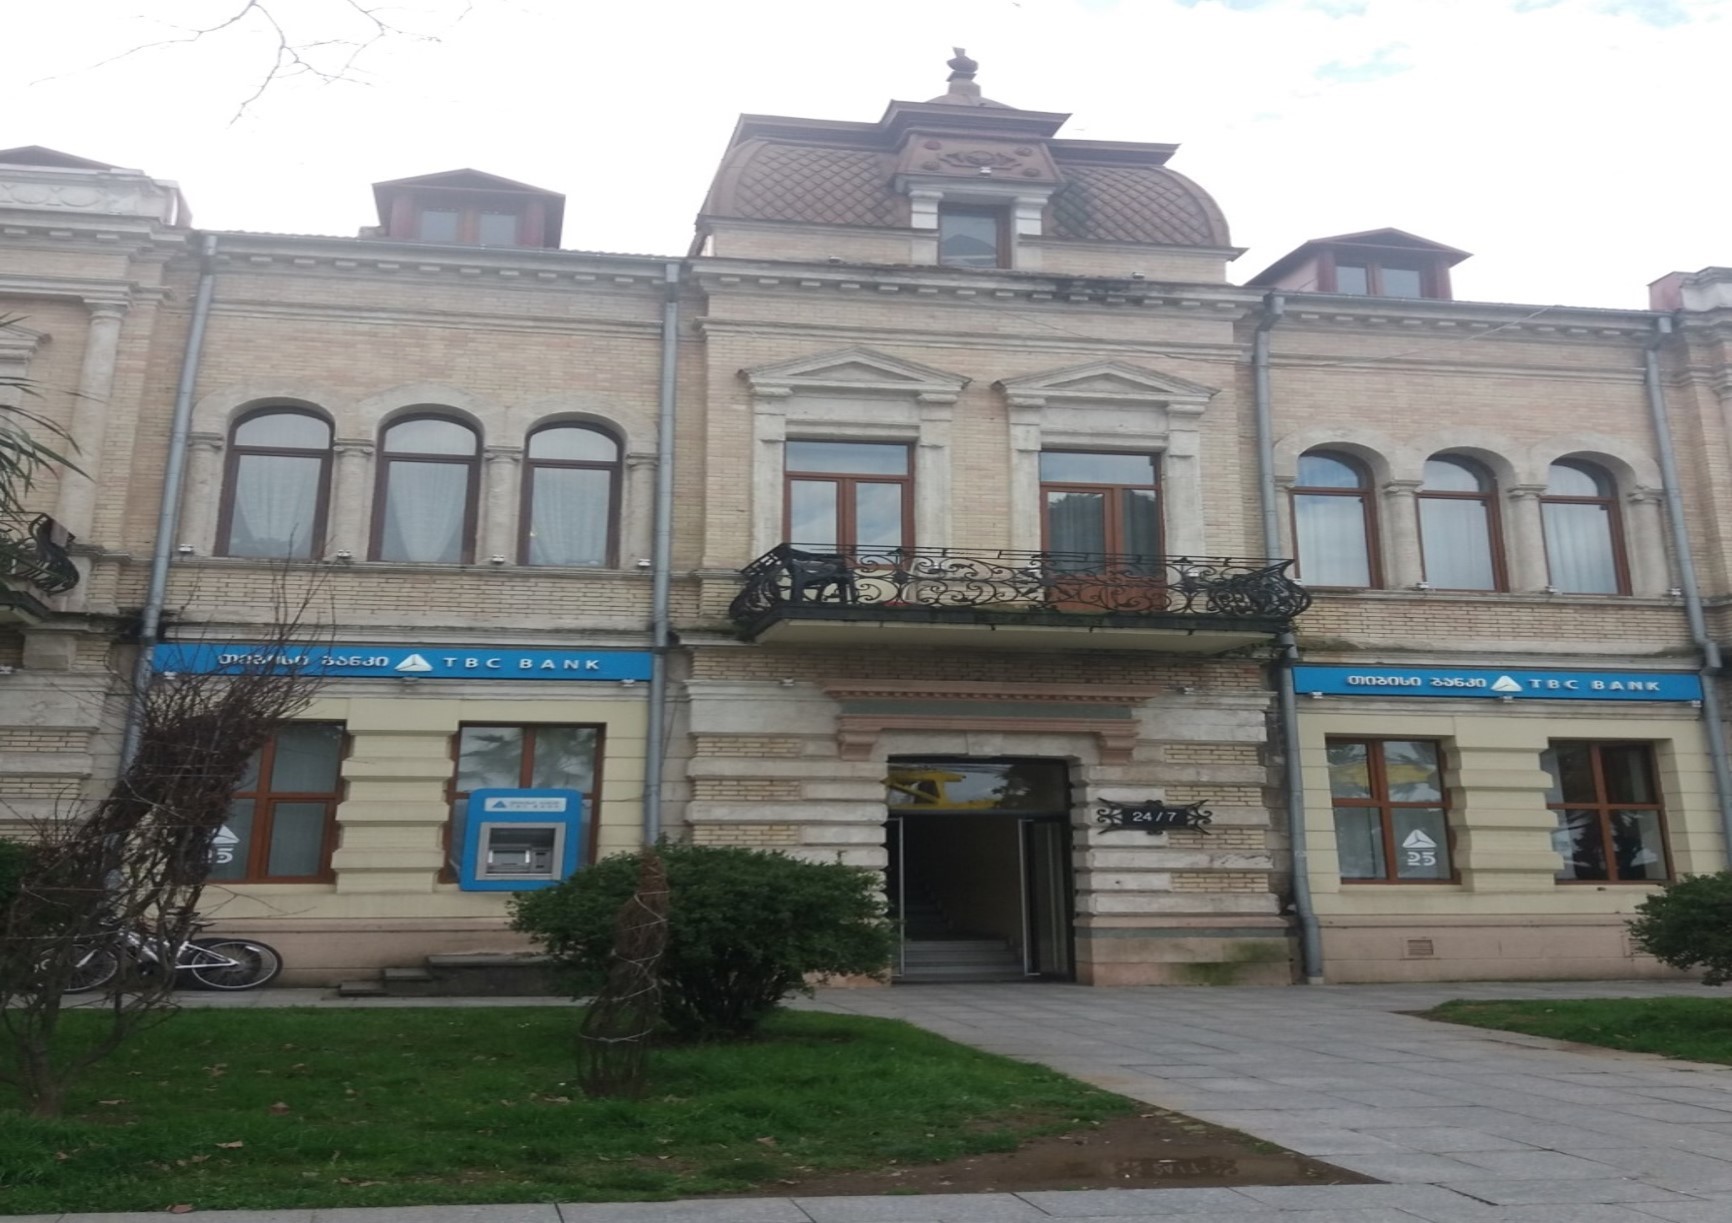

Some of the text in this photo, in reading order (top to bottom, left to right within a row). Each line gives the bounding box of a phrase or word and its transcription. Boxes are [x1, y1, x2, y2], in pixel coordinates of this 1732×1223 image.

[321, 655, 389, 667] ბანკი
[443, 657, 600, 670] TBC BANK
[1347, 675, 1487, 688] თიბისი ბანკი
[1527, 679, 1661, 691] TBC BANK
[1406, 851, 1437, 867] 25
